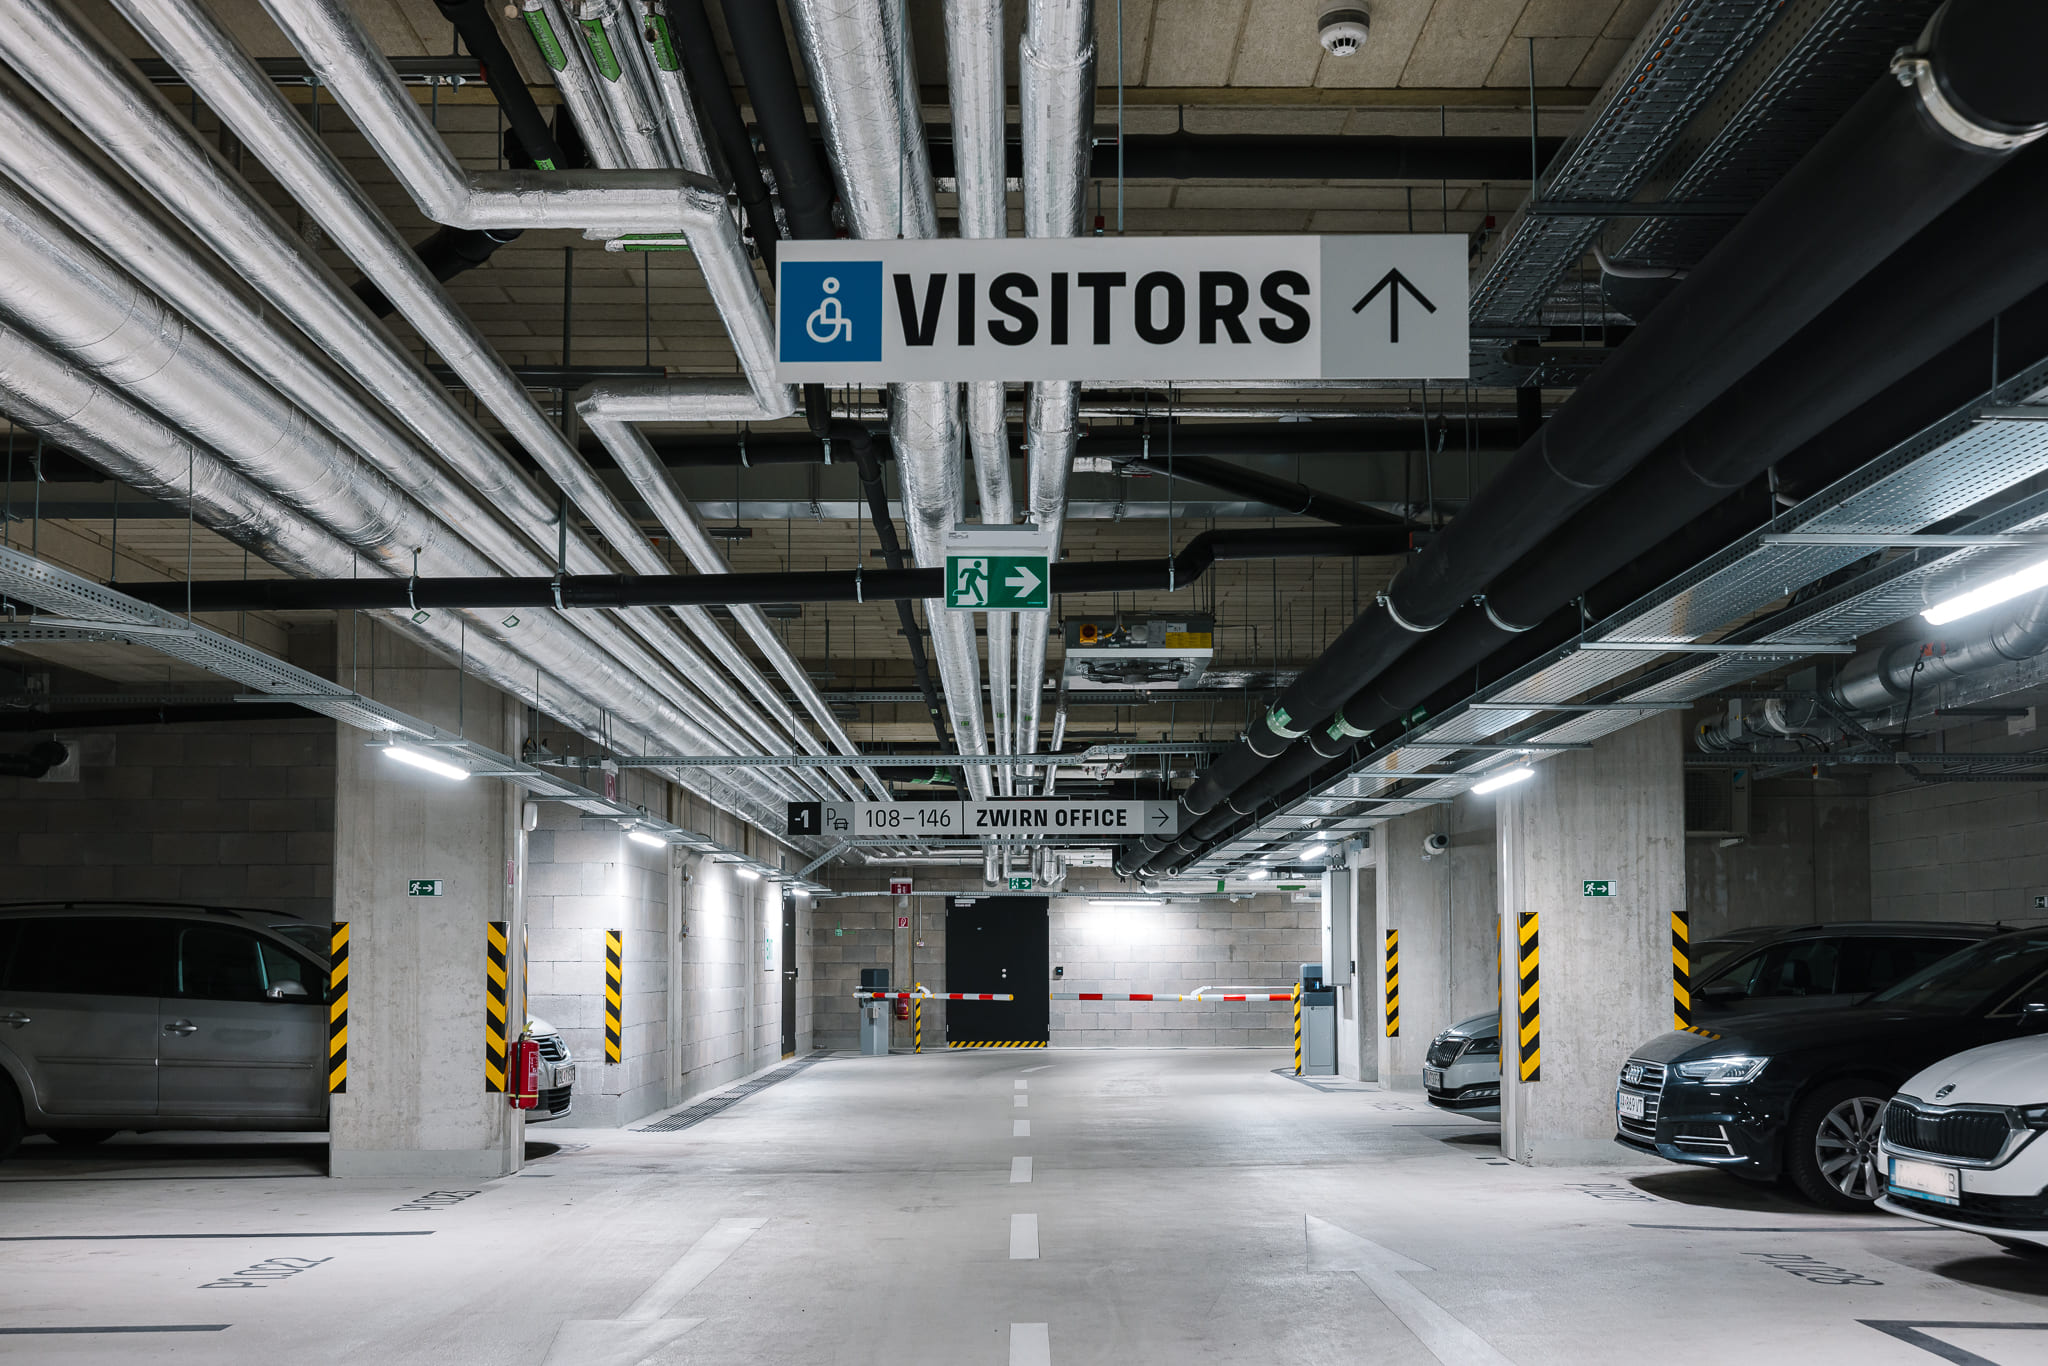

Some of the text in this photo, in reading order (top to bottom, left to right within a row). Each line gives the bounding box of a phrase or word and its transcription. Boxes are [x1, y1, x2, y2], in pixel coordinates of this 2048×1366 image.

[893, 270, 1311, 346] VISITORS
[795, 809, 809, 828] -1
[826, 808, 837, 827] P
[976, 809, 1048, 827] ZWIRN
[1055, 809, 1128, 827] OFFICE
[197, 1256, 335, 1289] P1.022
